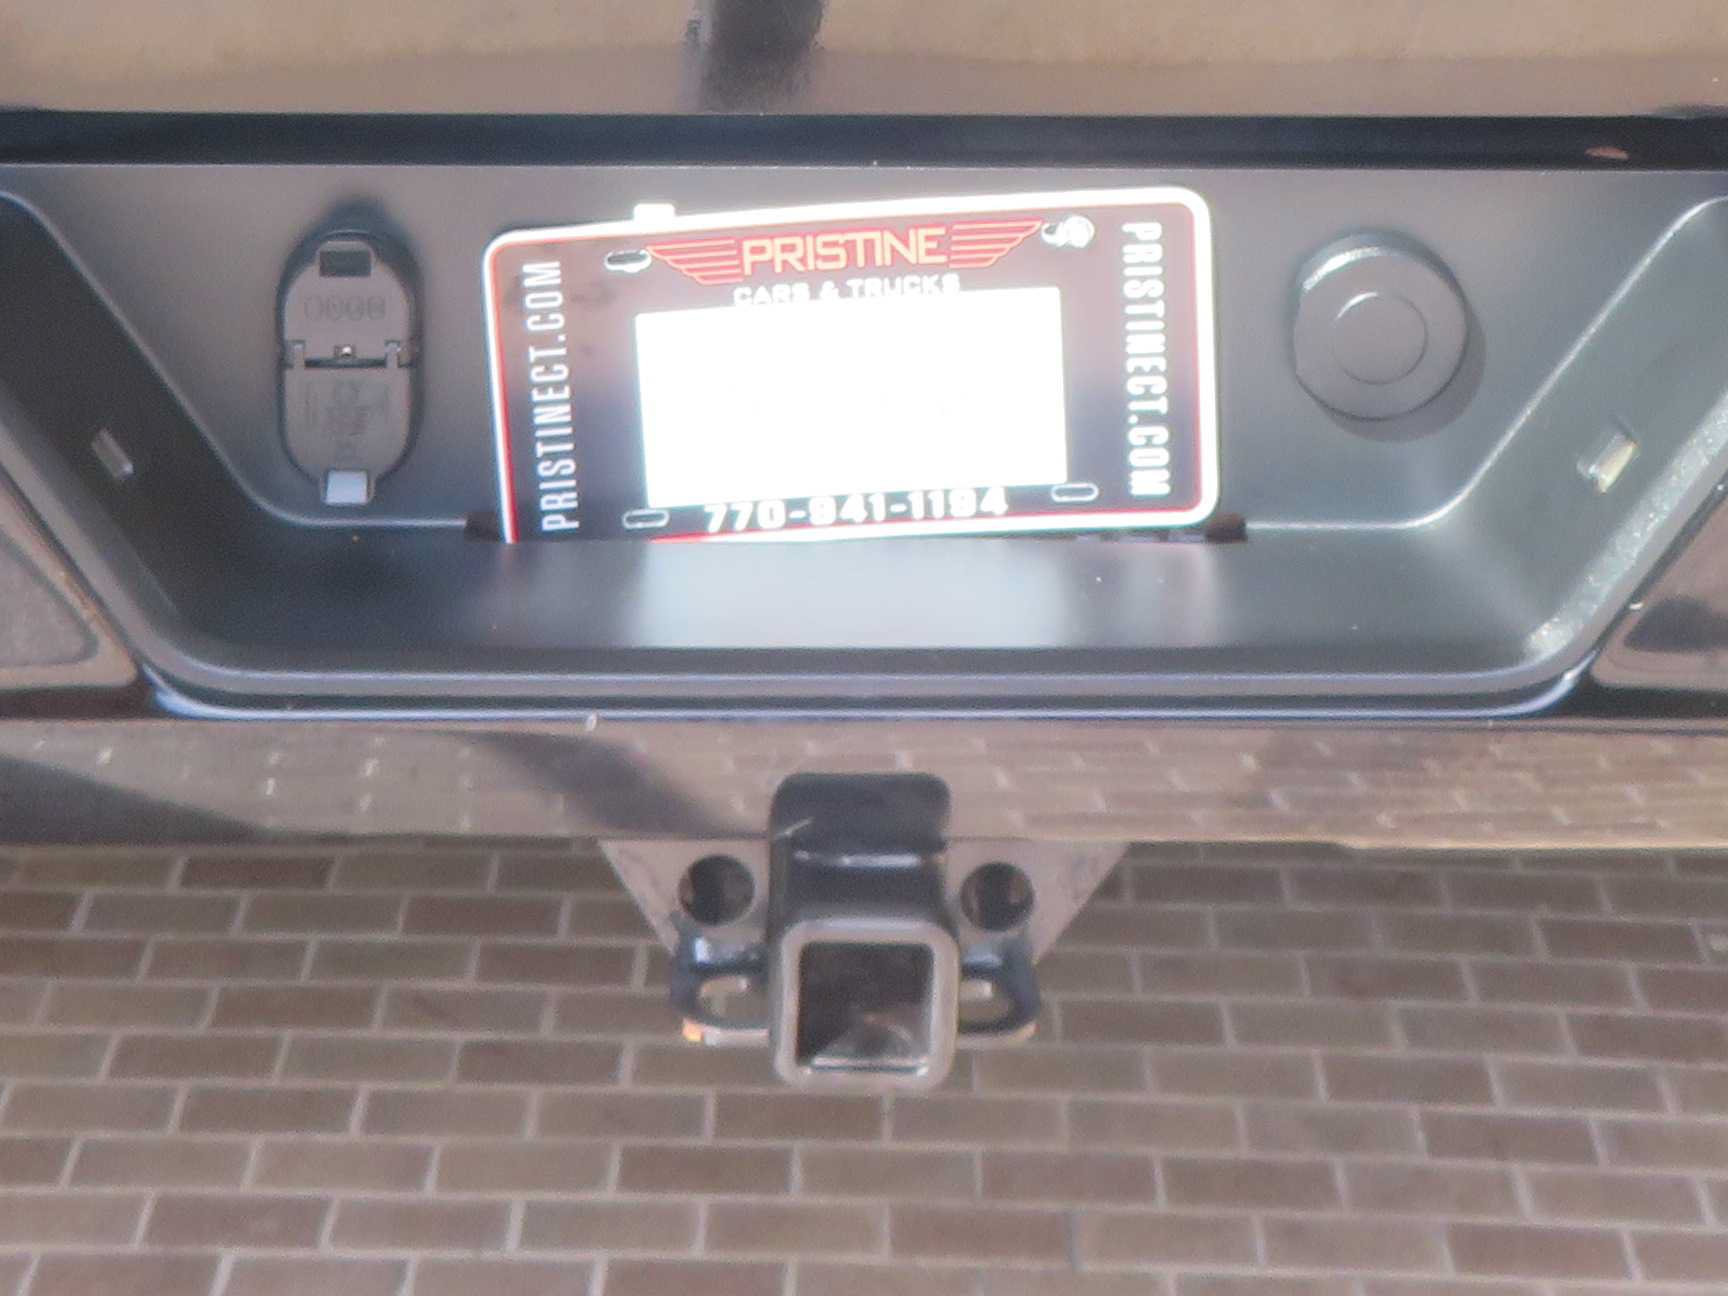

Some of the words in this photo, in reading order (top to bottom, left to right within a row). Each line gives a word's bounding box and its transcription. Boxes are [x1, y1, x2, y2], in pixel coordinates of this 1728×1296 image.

[733, 282, 810, 307] CARS
[846, 273, 961, 299] TRUCKS
[742, 226, 948, 276] PRISTINE
[522, 260, 580, 532] PRISTINECT.COM
[1122, 221, 1171, 496] PRISTINECT.COM
